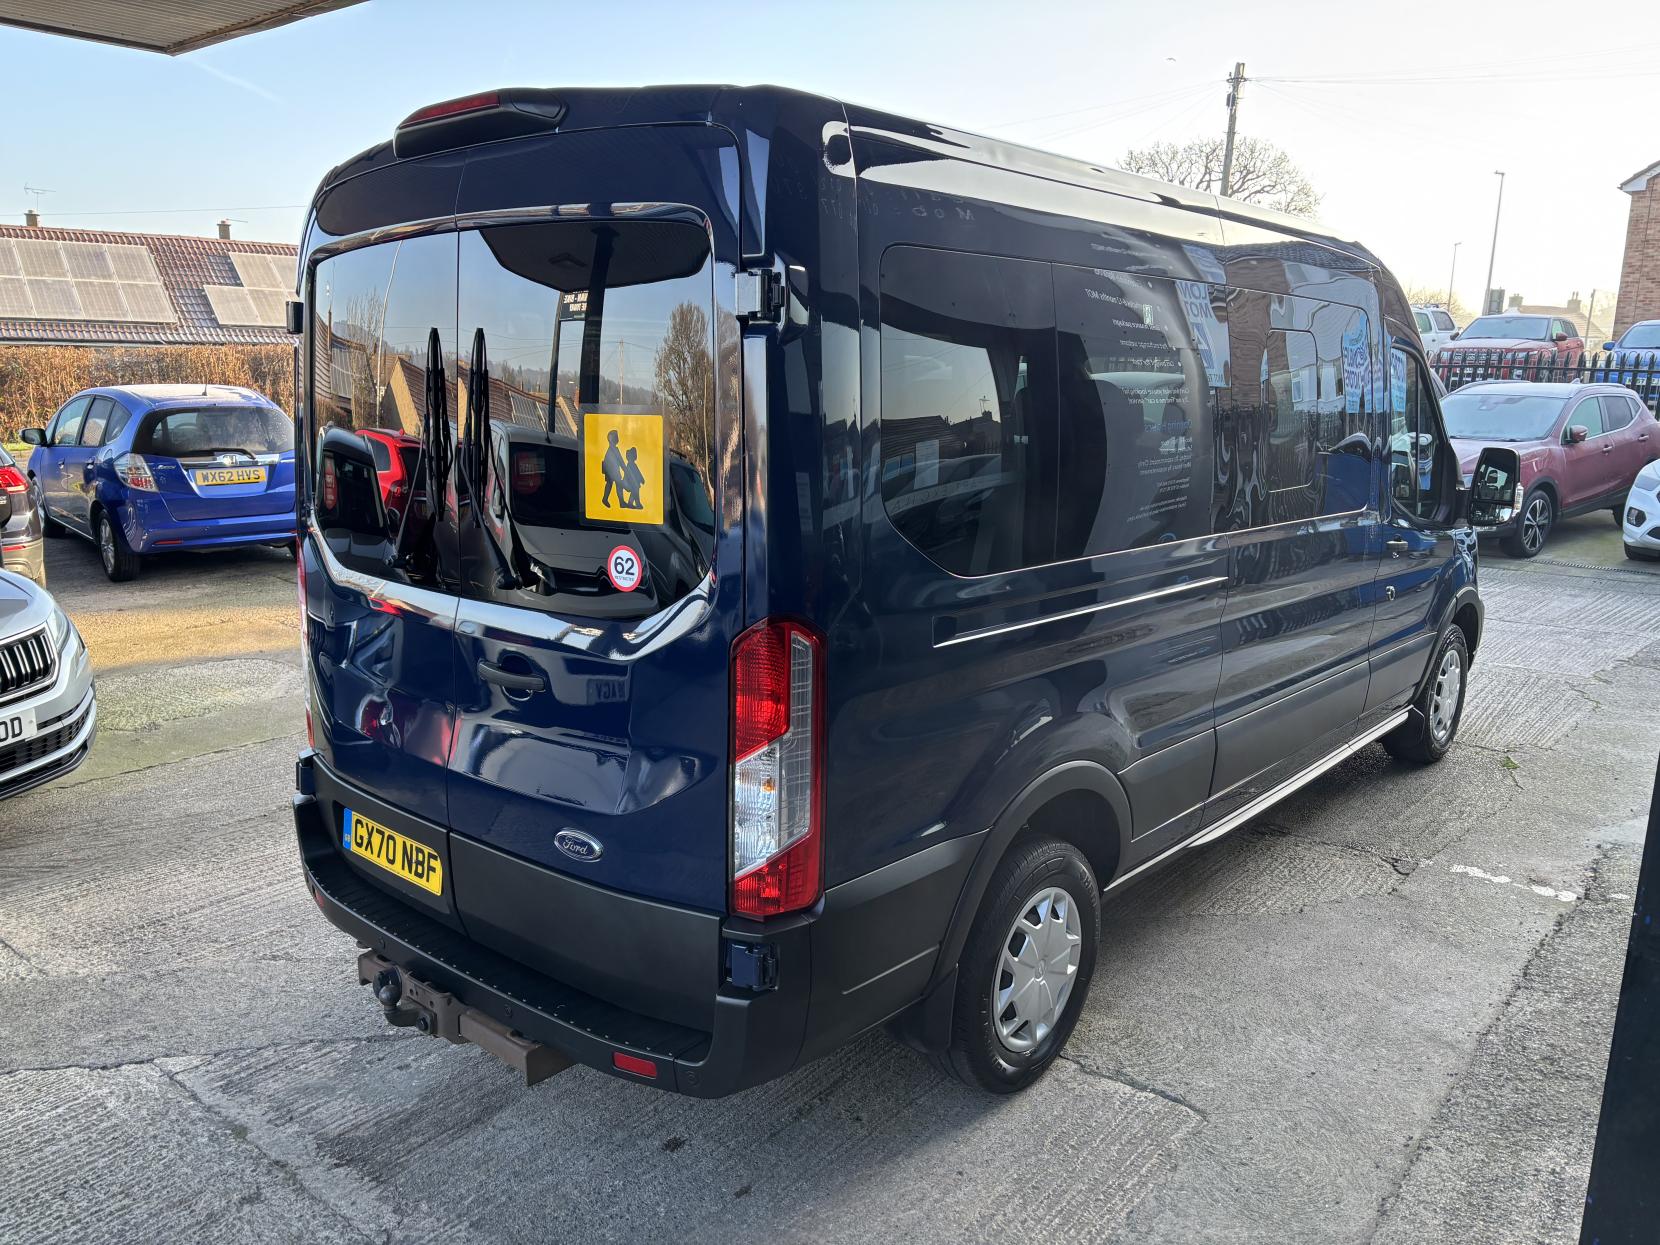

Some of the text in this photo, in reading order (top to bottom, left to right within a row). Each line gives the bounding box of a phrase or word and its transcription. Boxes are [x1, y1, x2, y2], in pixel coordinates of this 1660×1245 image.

[201, 469, 261, 483] WX62 HVS
[614, 556, 635, 576] 62
[354, 818, 438, 883] GX70 NBF
[562, 835, 588, 855] Ford
